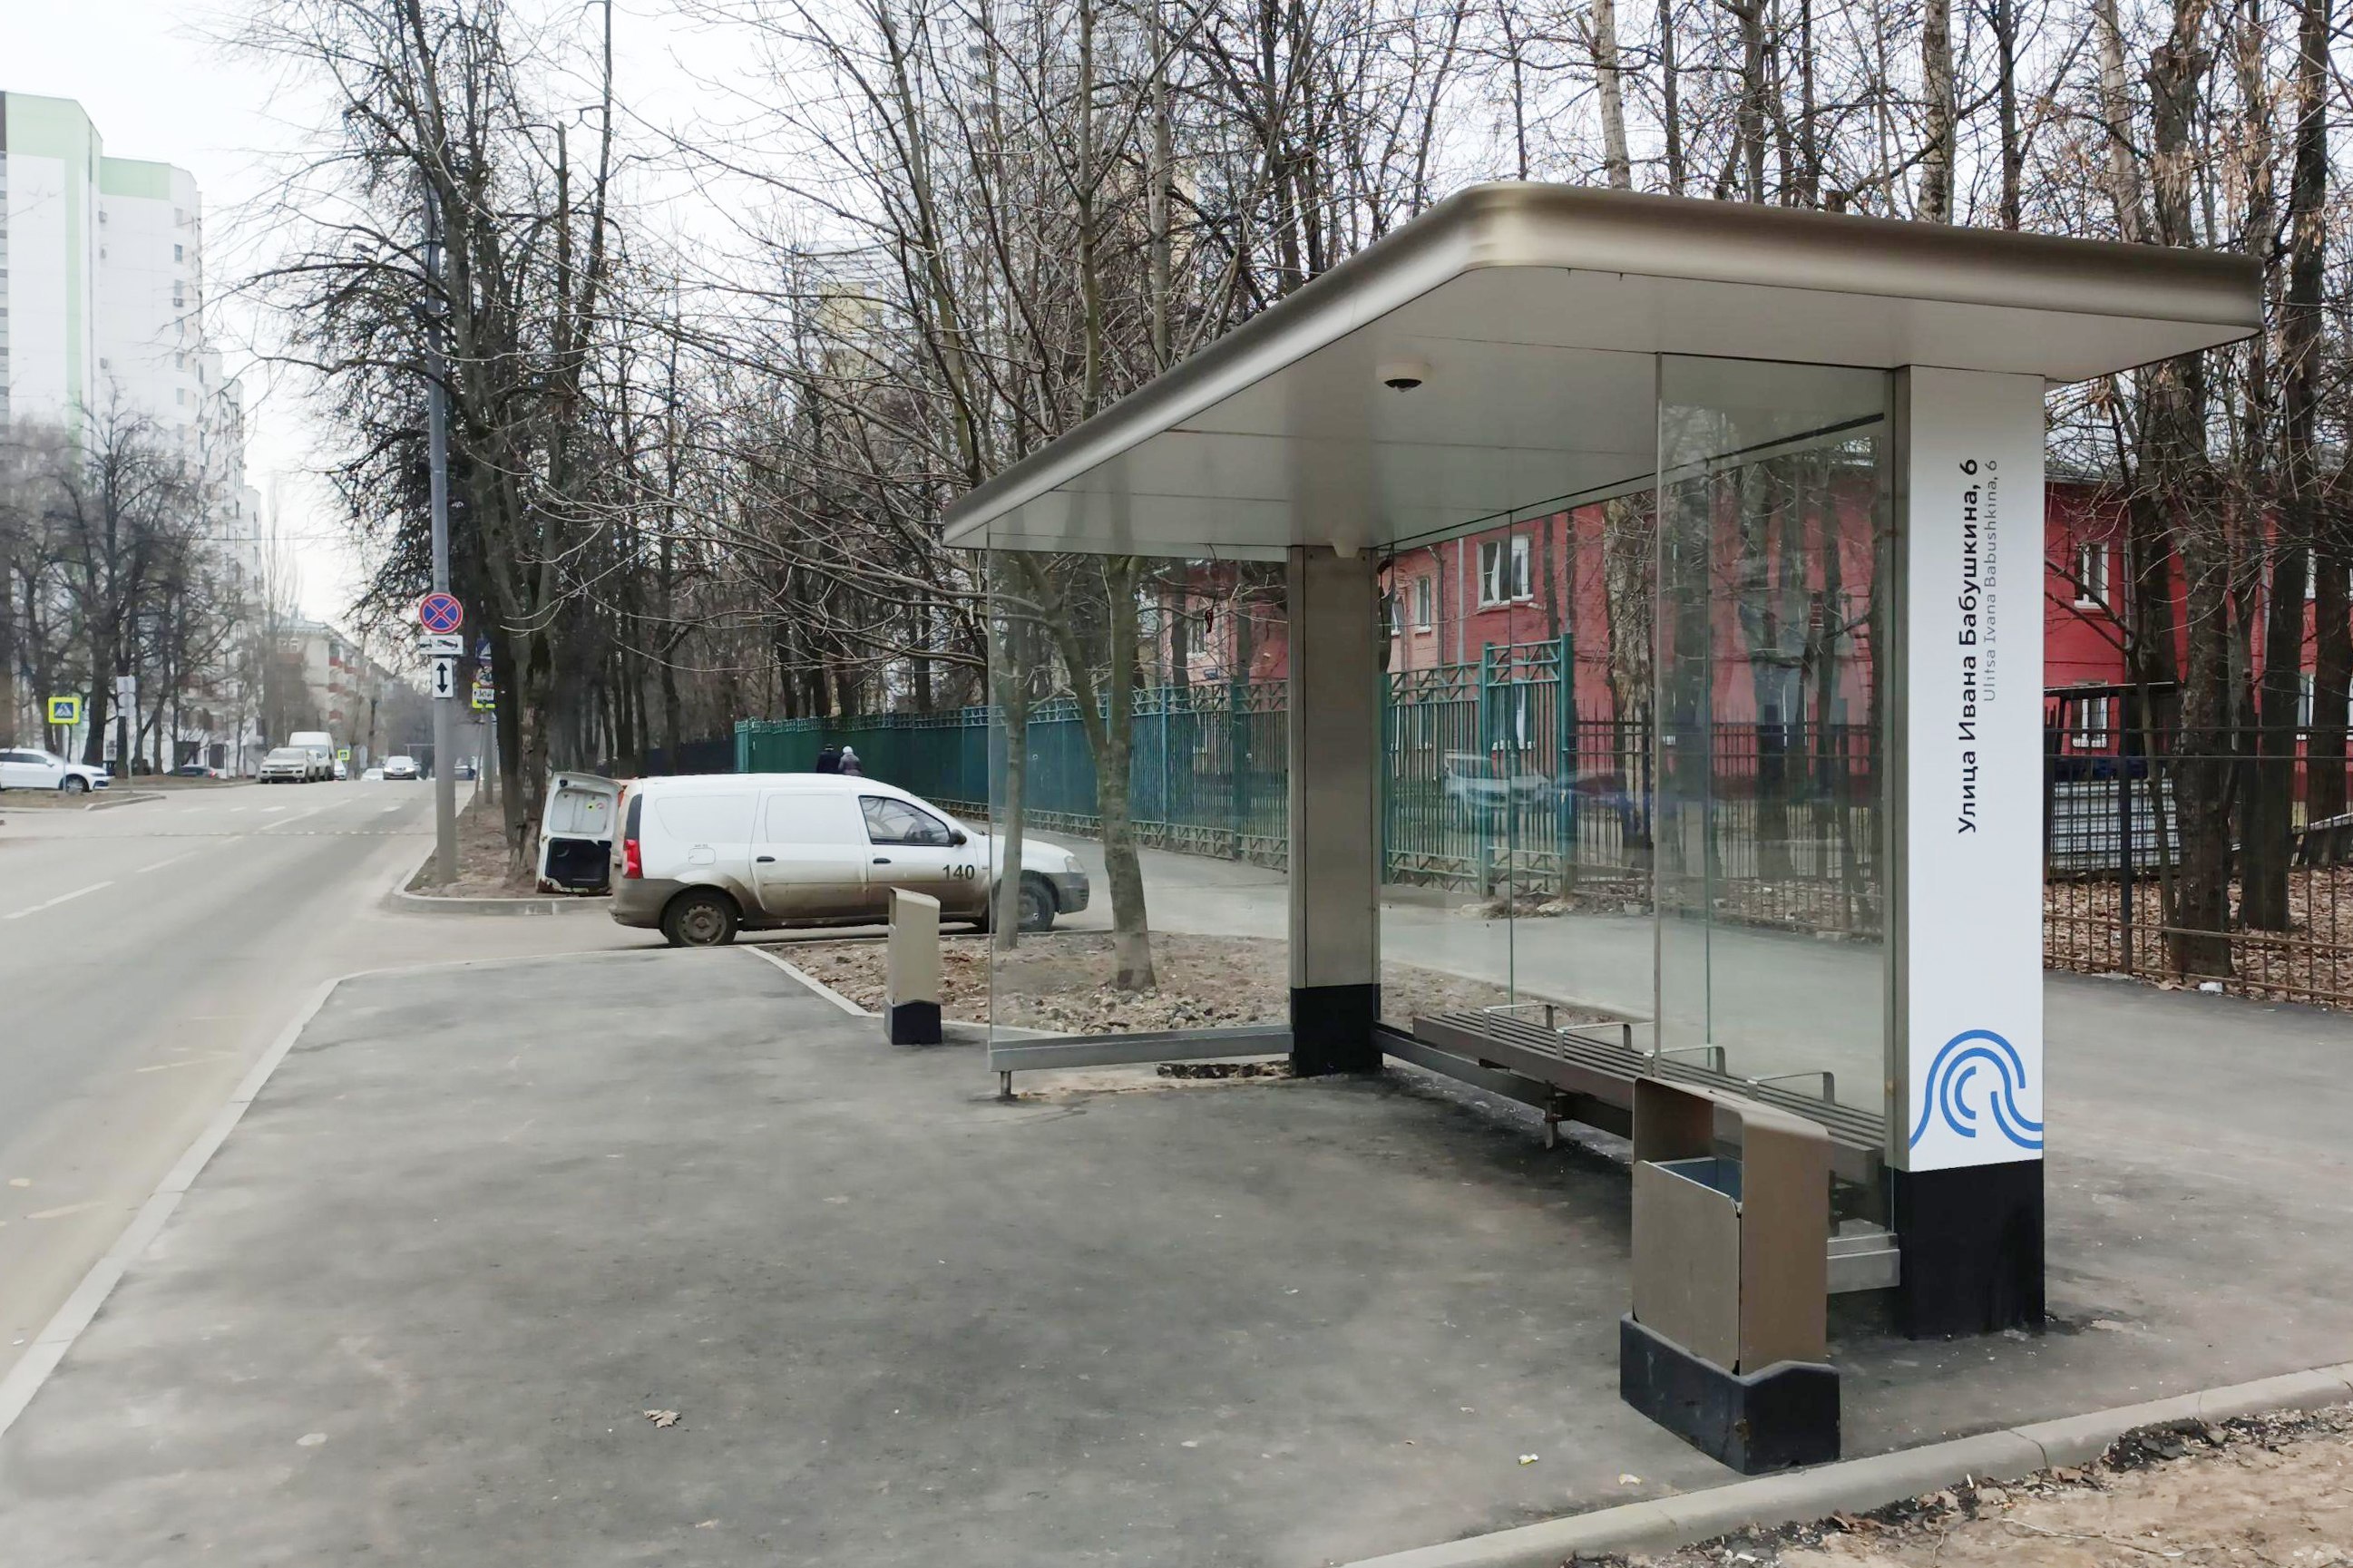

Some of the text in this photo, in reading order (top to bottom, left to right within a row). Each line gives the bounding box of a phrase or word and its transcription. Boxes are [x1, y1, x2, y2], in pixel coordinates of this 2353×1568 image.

[1958, 459, 1981, 833] Улица Ивана Бабушкина, 6
[1983, 460, 1999, 701] Ulitsa Ivana Babushkina, 6
[942, 864, 975, 881] 140
